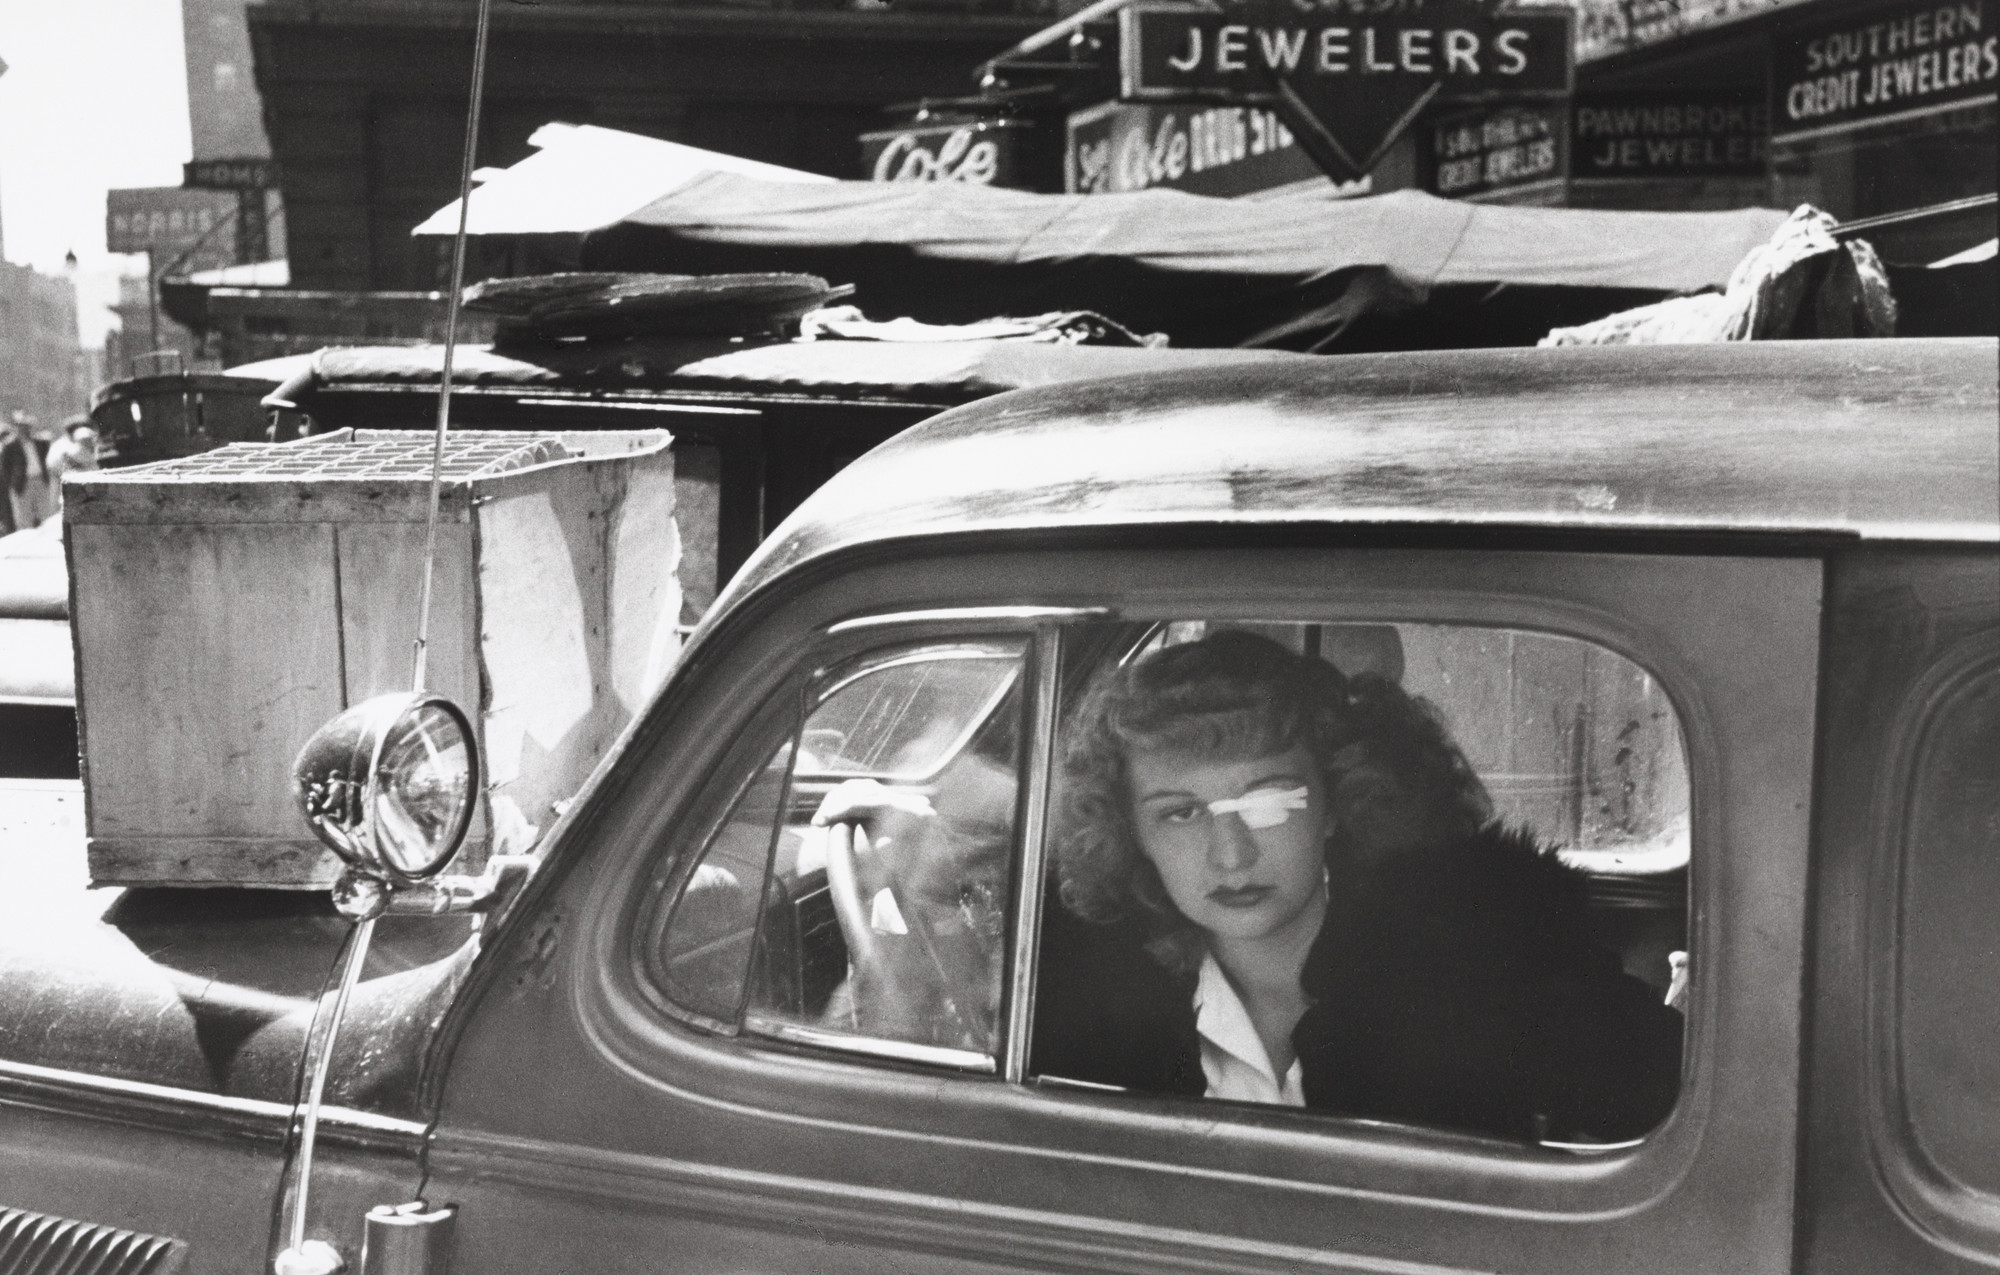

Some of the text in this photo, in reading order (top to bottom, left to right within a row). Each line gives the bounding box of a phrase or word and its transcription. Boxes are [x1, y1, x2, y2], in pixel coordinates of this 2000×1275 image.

[1168, 25, 1530, 75] JEWELERS
[1806, 1, 1982, 72] SOUTHERN
[1787, 36, 1999, 120] CREDIT JEWELERS
[873, 127, 998, 184] Cole
